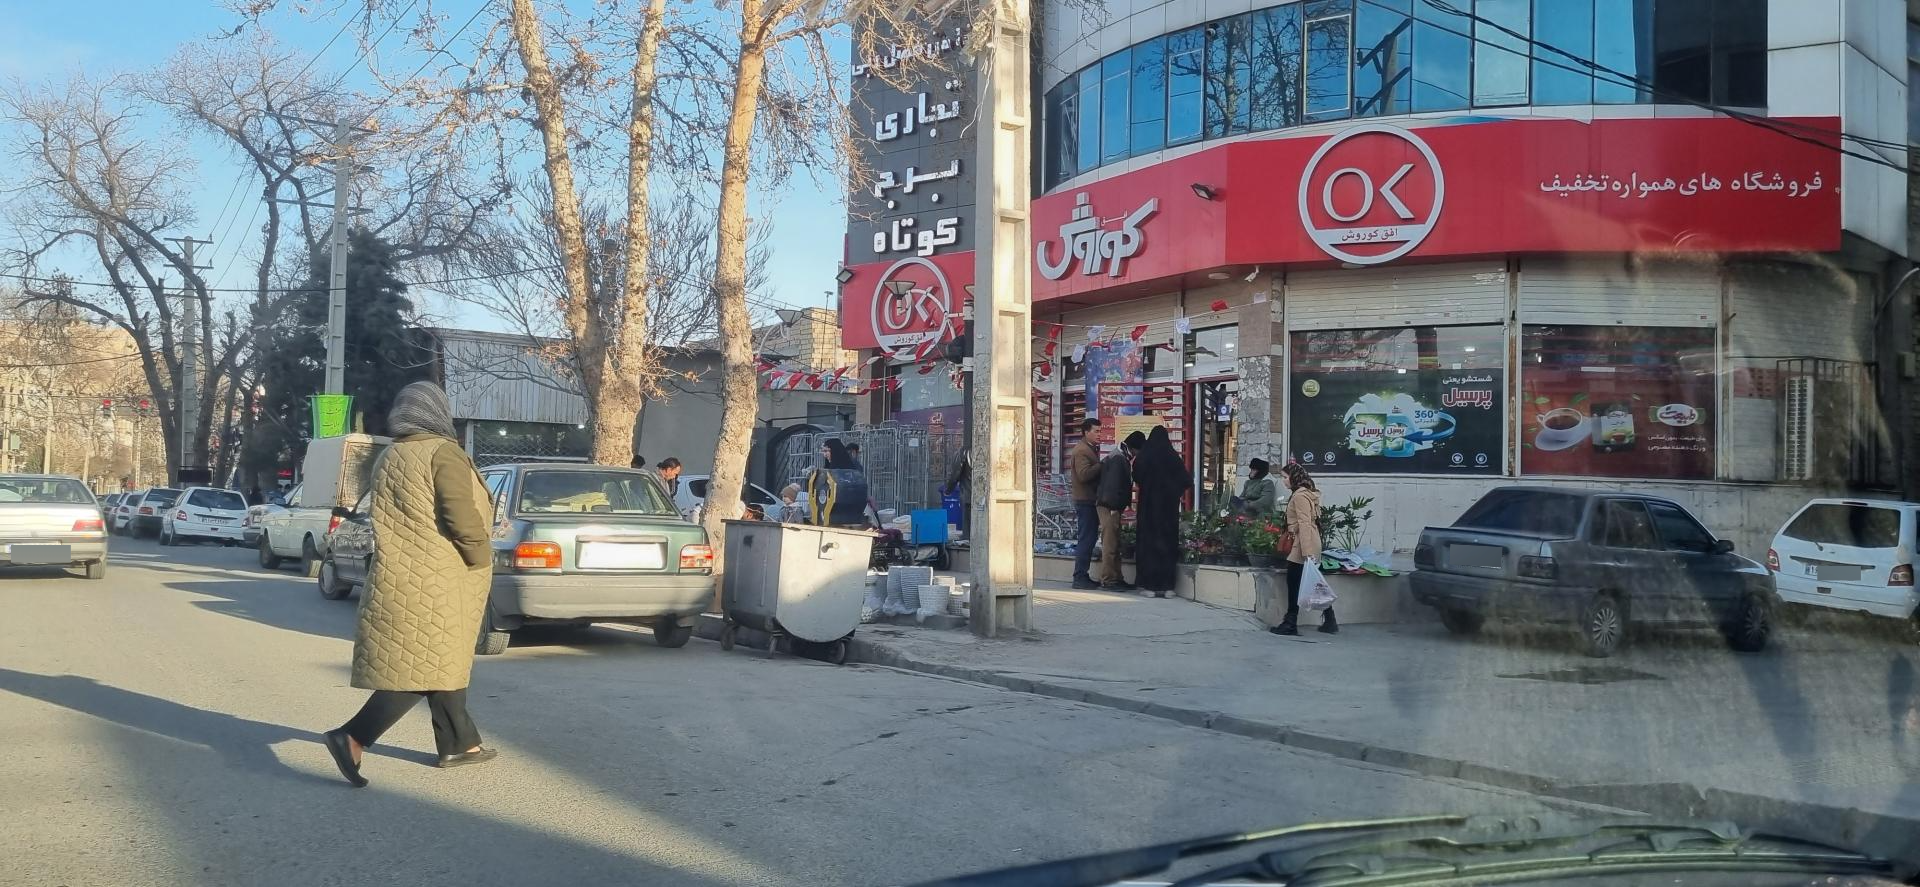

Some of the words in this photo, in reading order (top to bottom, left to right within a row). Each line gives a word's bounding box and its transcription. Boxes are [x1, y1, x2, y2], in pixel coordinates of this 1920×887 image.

[875, 80, 960, 141] تجاری
[875, 159, 959, 209] برج
[1323, 163, 1415, 222] OK
[1540, 174, 1610, 197] تخفیف
[1611, 172, 1677, 198] همواره
[1679, 172, 1722, 196] های
[1731, 171, 1822, 198] فروشگاه
[873, 217, 959, 257] کوتاه
[1036, 192, 1159, 280] کوروش
[1341, 229, 1380, 241] کوروش
[1380, 228, 1398, 241] افق
[1442, 375, 1461, 385] یعنی
[1460, 375, 1493, 384] شستشو
[1442, 387, 1493, 410] پرسیل
